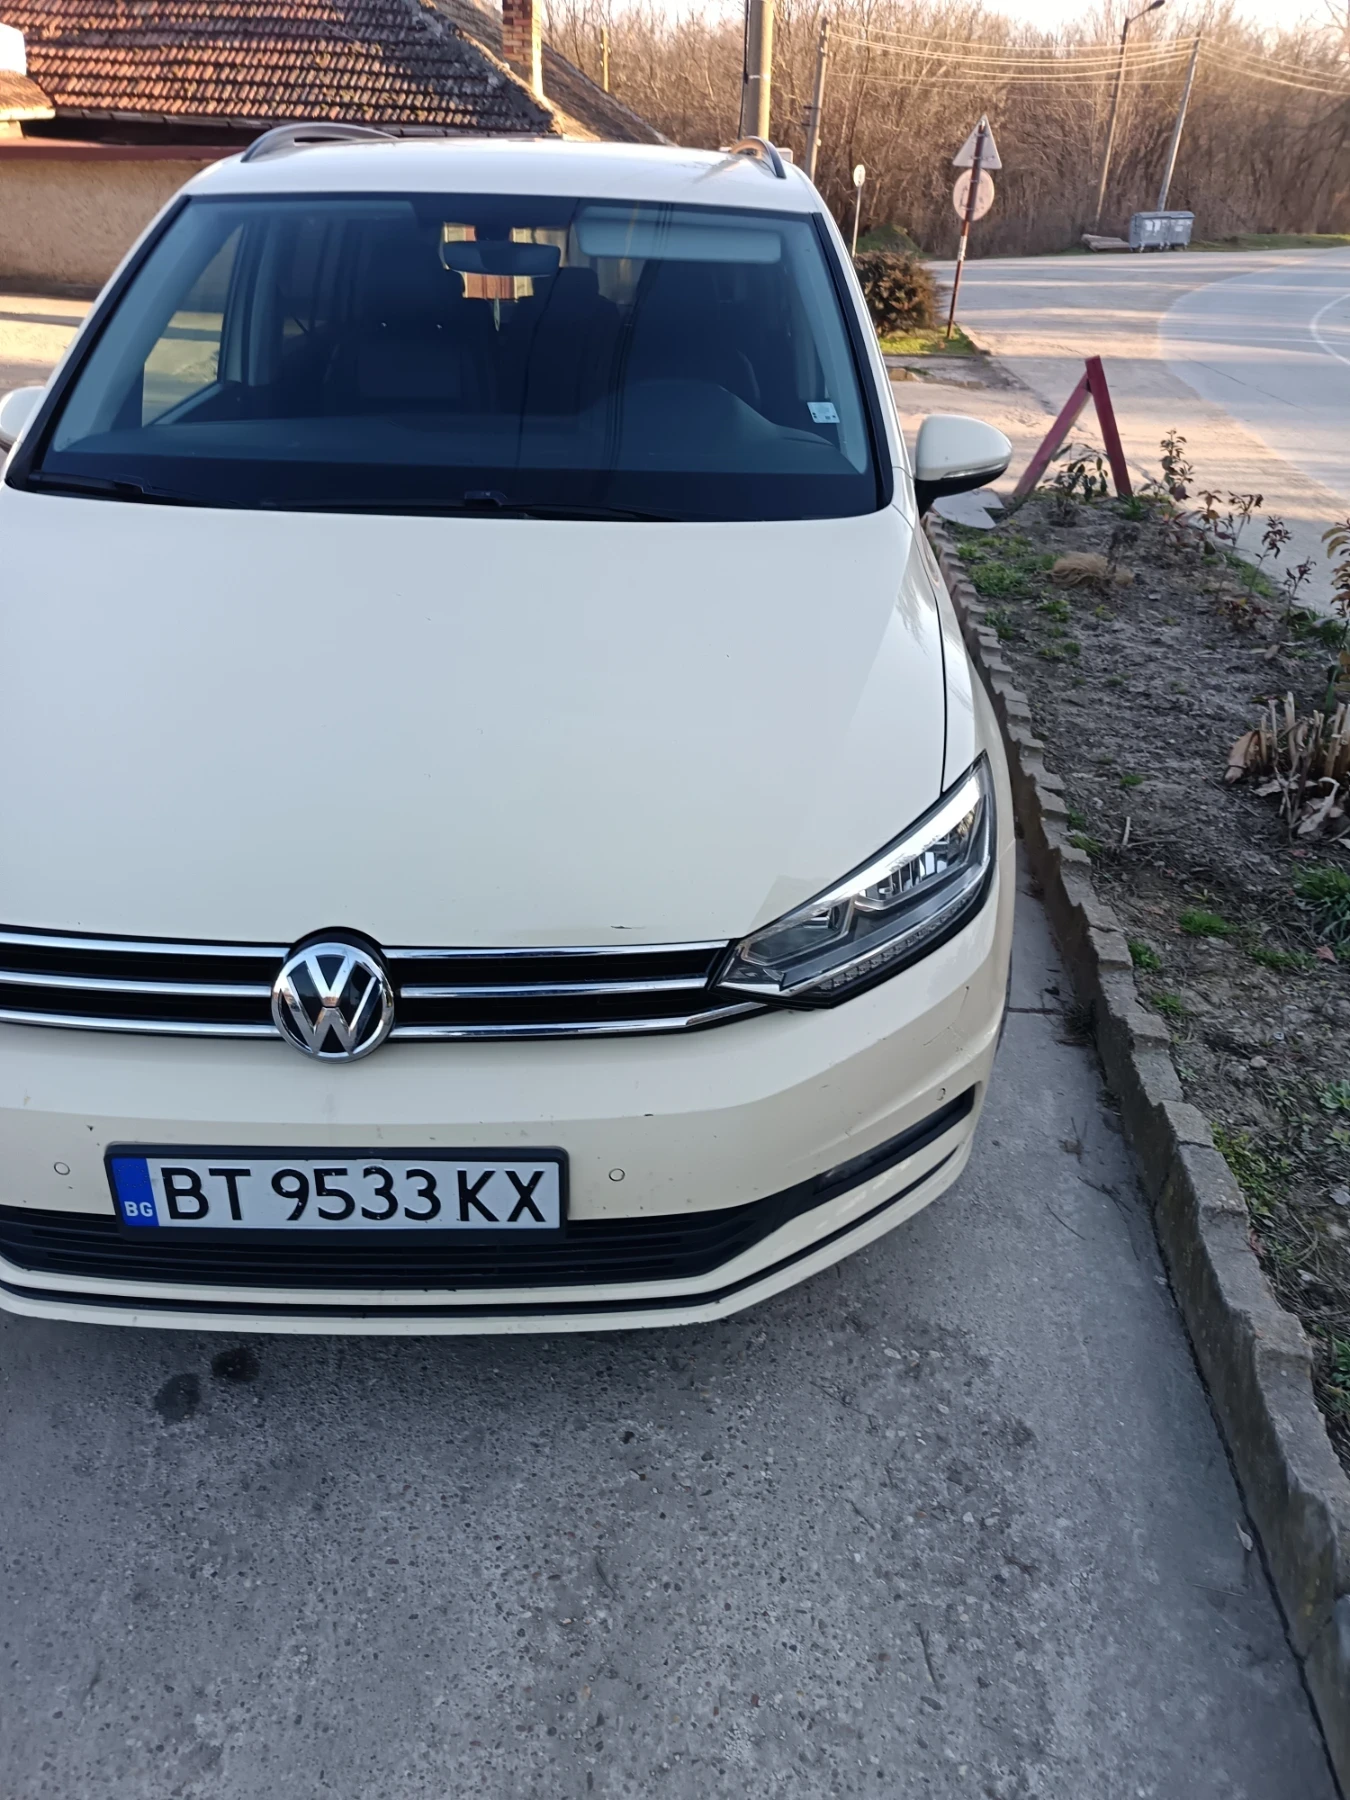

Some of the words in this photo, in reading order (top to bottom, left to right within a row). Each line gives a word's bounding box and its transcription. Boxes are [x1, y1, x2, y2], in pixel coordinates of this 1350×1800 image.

[273, 943, 393, 1062] VW
[124, 1201, 154, 1217] BG
[160, 1167, 251, 1221] BT
[271, 1166, 441, 1222] 9533
[457, 1169, 547, 1223] KX
